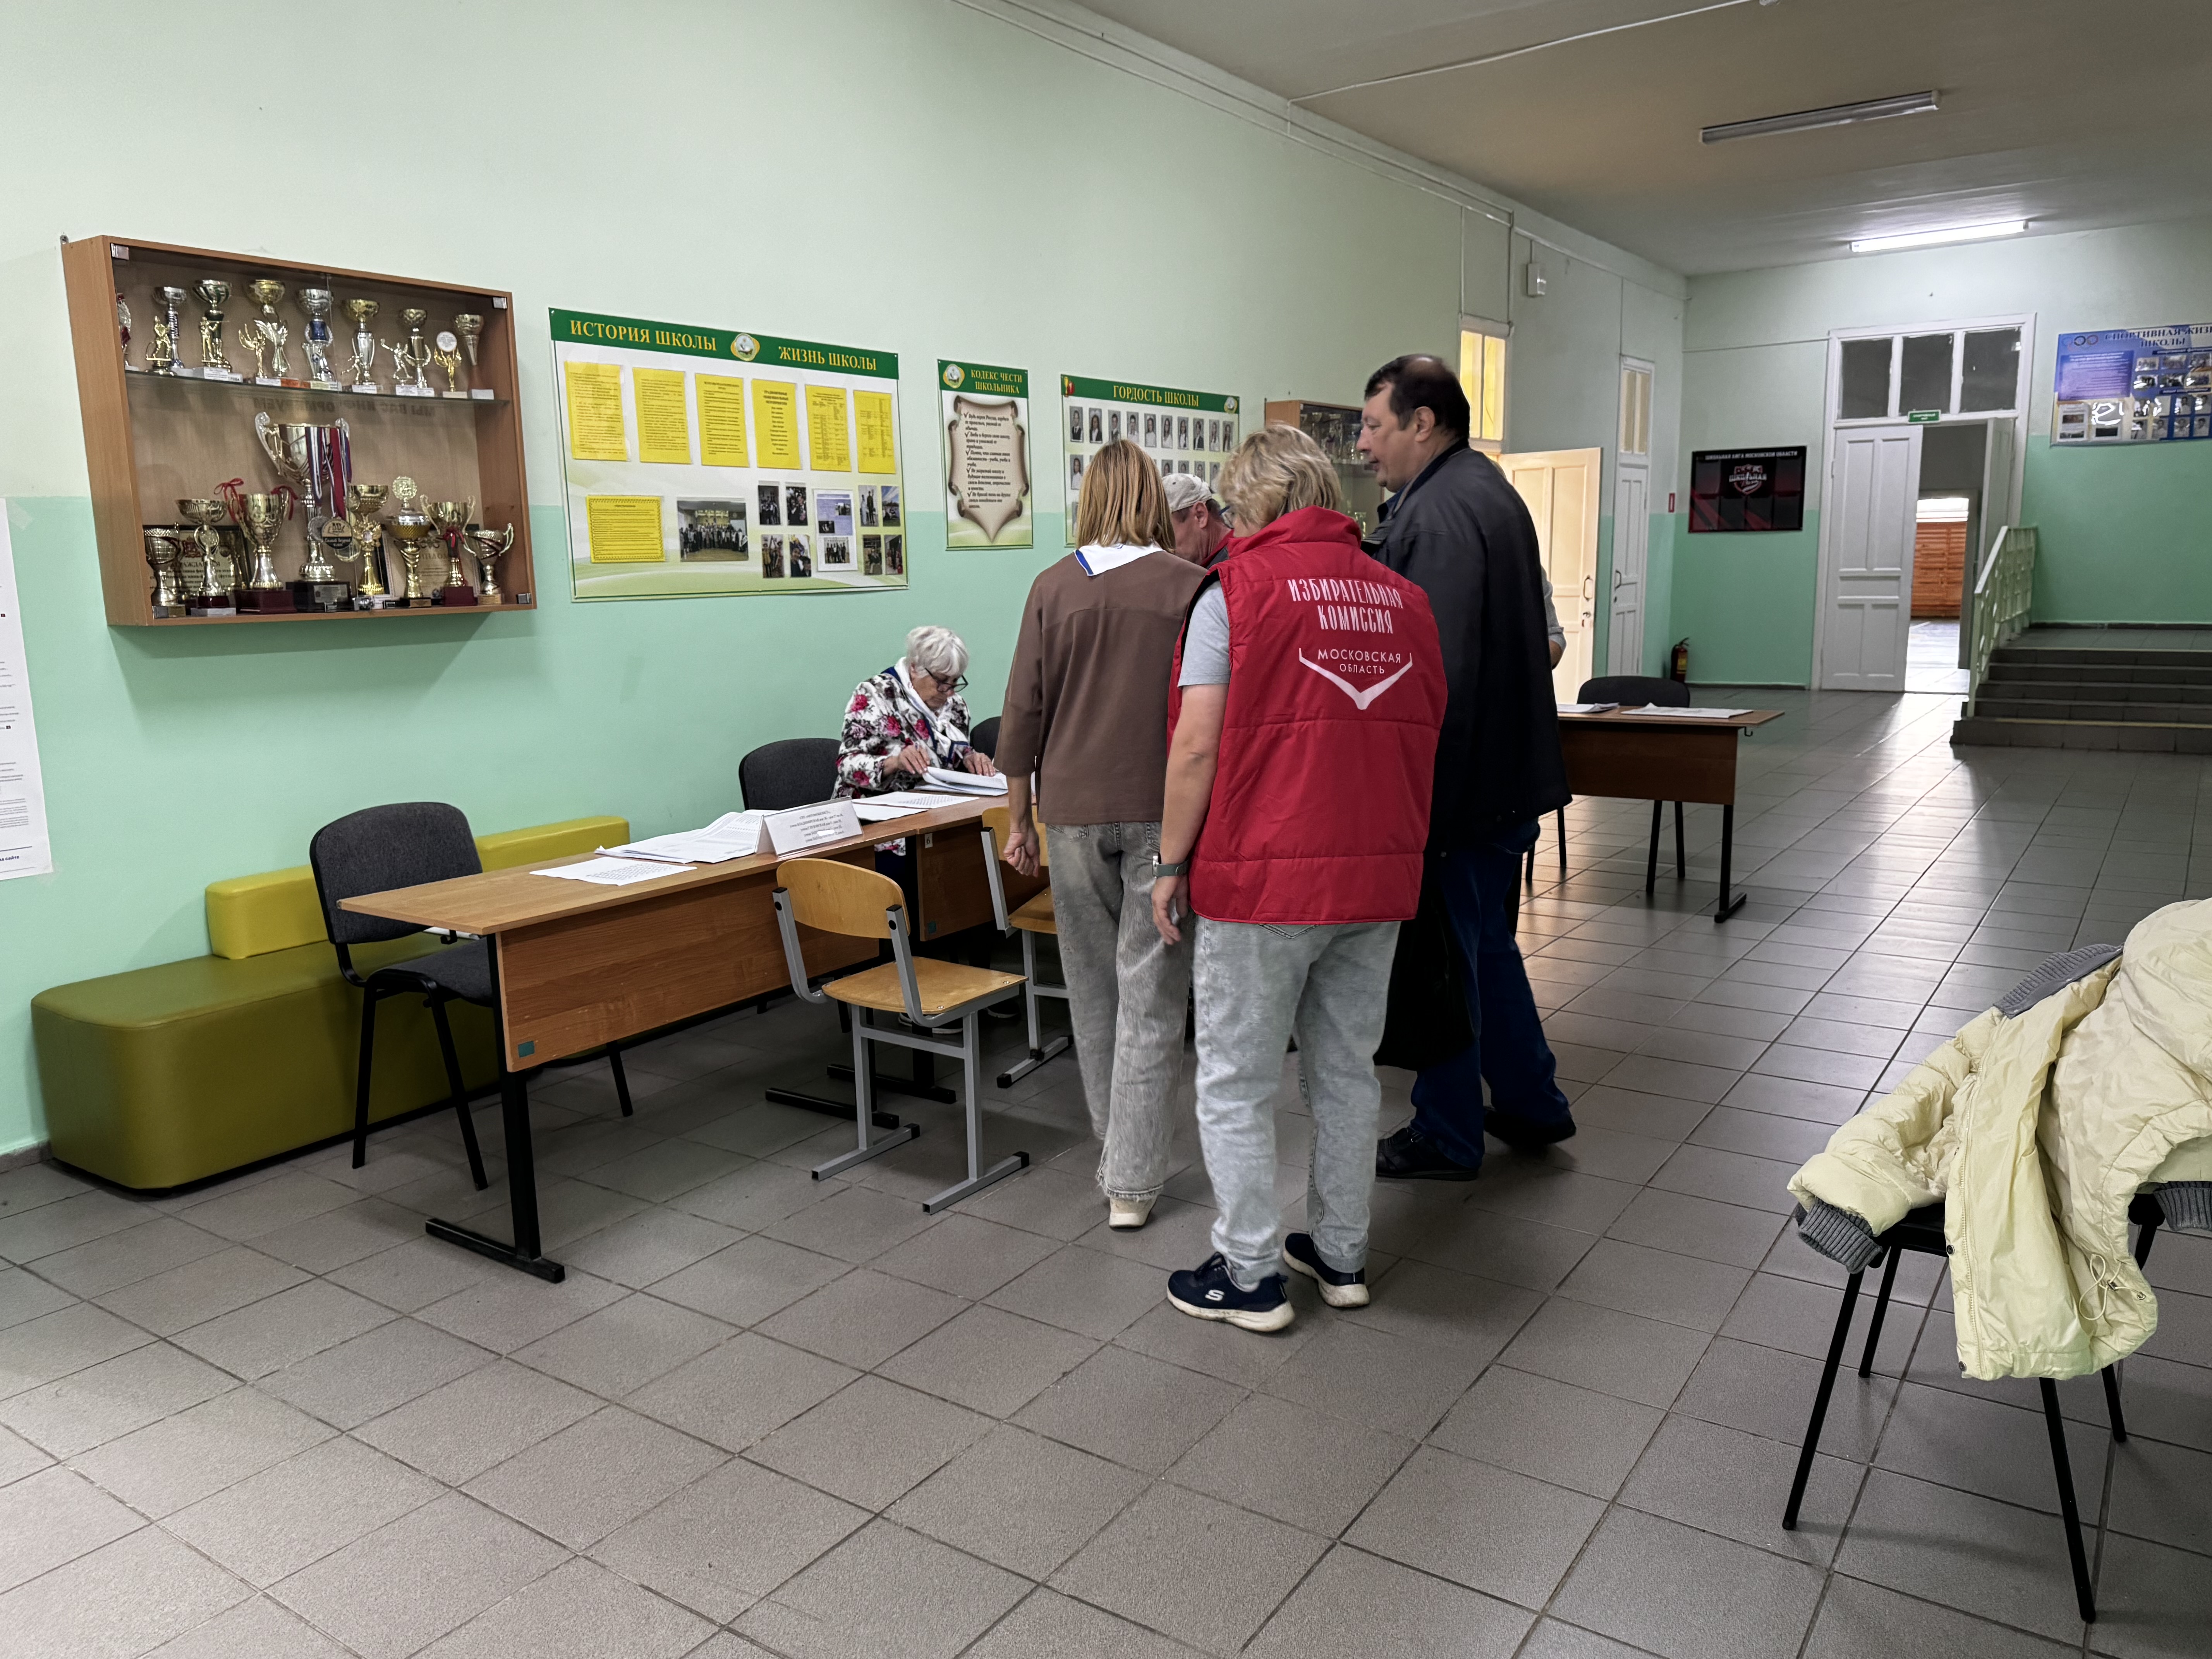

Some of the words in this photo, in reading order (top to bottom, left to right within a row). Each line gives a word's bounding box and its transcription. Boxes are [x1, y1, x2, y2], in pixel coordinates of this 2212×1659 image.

[570, 320, 650, 343] ИСТОРИЯ
[655, 330, 717, 351] ШКОЛЫ
[2105, 328, 2181, 340] СПОРТИВНАЯ
[2141, 338, 2185, 347] ШКОЛЫ
[778, 346, 825, 364] ЖИЗНЬ
[829, 352, 877, 371] ШКОЛЫ
[971, 369, 999, 381] КОДЕКС
[1000, 373, 1022, 383] ЧЕСТИ
[975, 381, 1019, 394] ШКОЛЬНИКА
[1113, 385, 1163, 402] ГОРДОСТЬ
[1164, 391, 1199, 407] ШКОЛЫ
[1287, 579, 1403, 609] ИЗБИРАТЕЛЬНАЯ
[1317, 605, 1393, 634] КОМИССИЯ
[1318, 649, 1401, 663] МОСКОВСКАЯ
[1340, 663, 1385, 674] ОБЛАСТЬ
[1205, 1289, 1225, 1302] S
